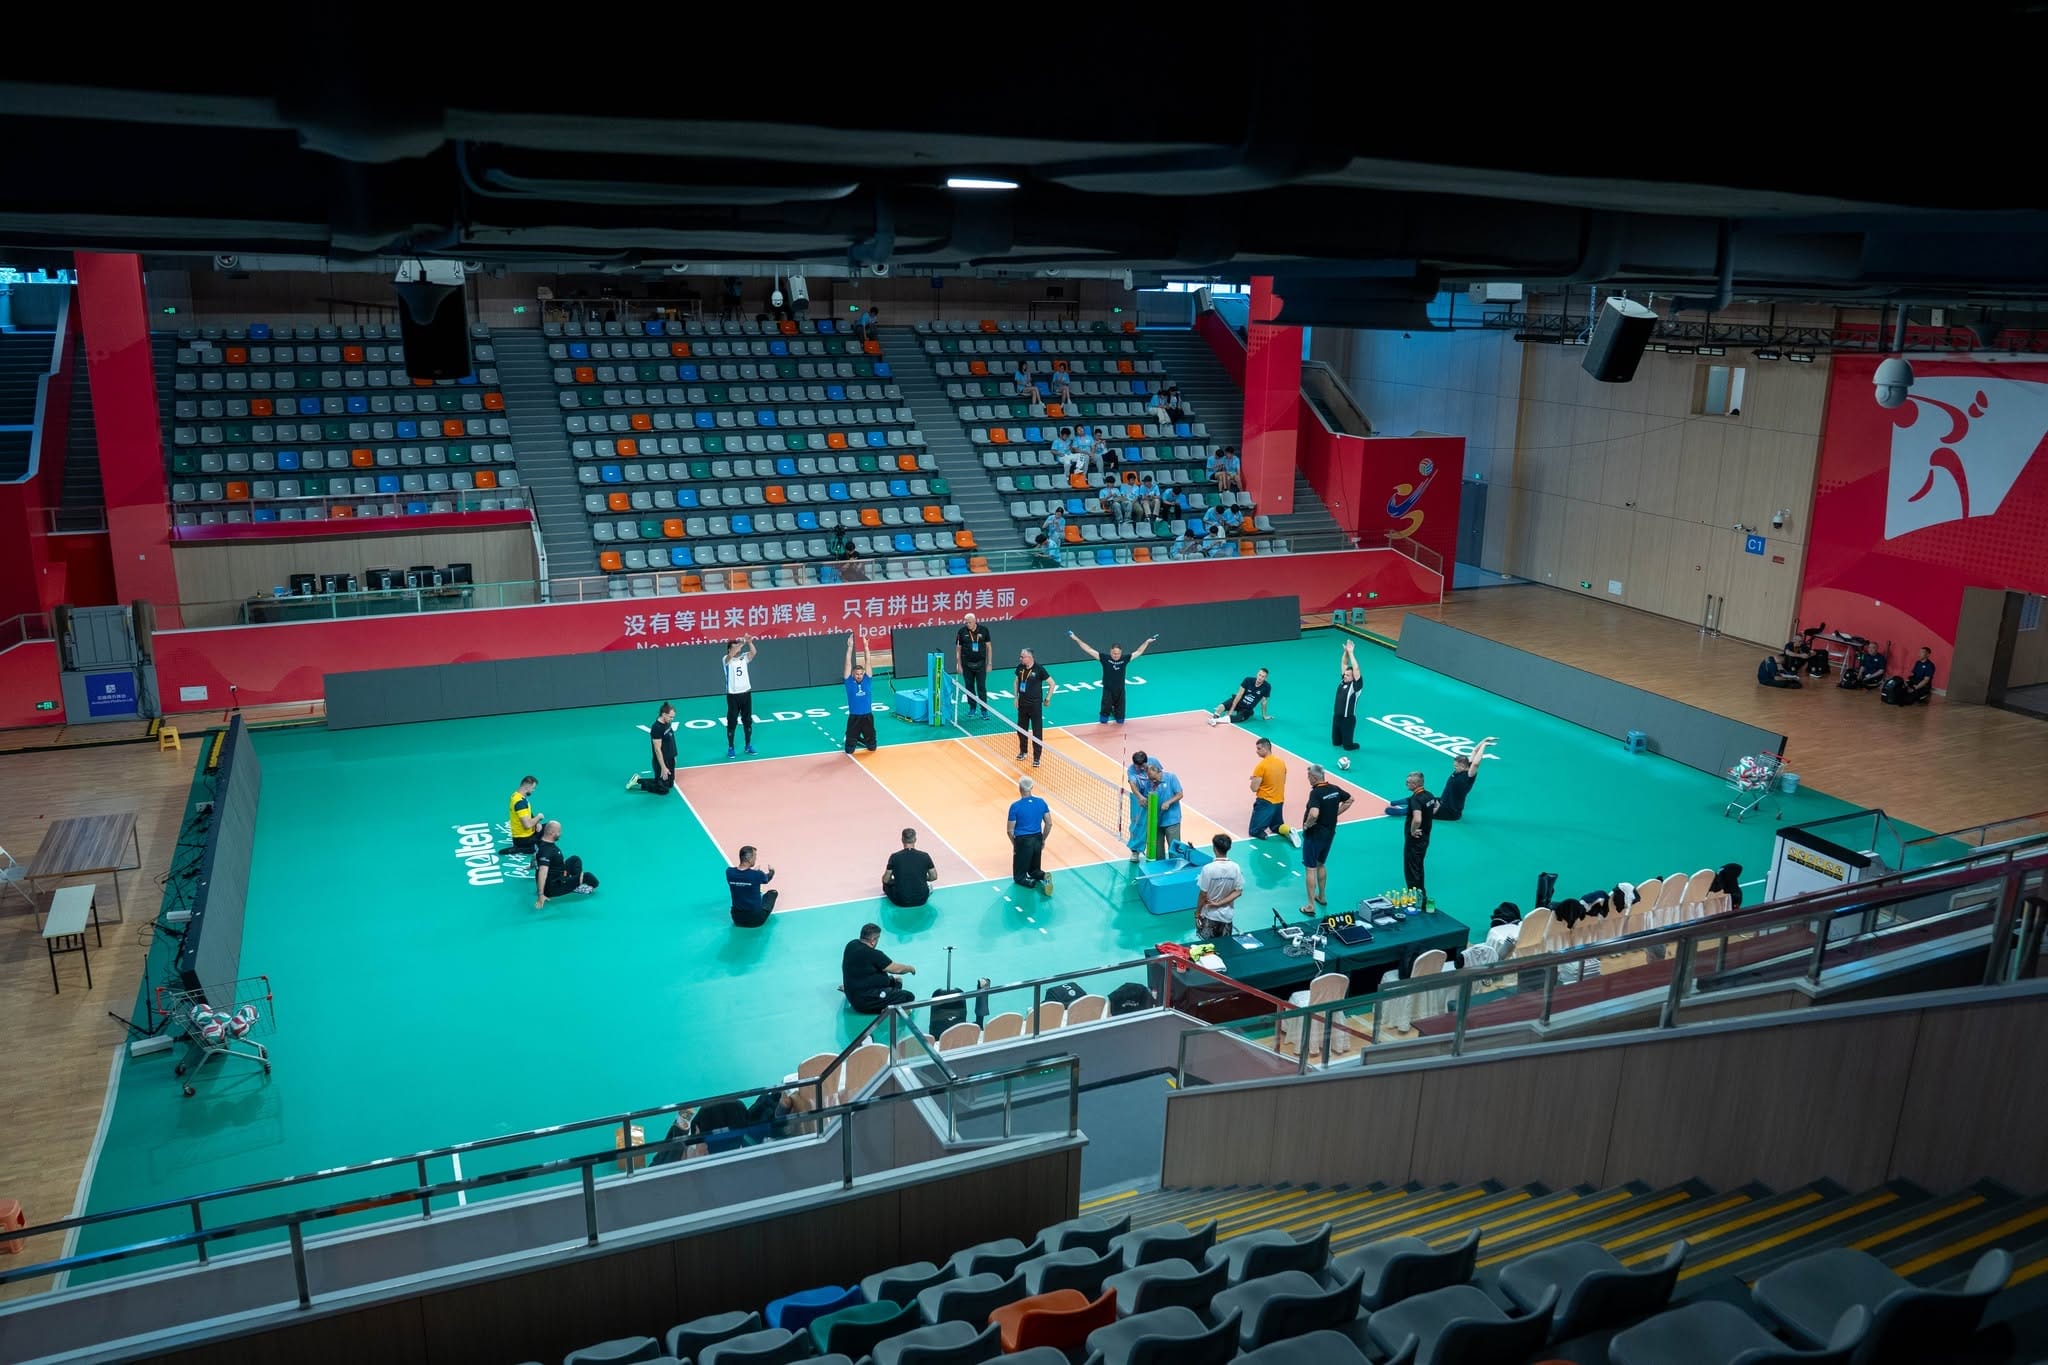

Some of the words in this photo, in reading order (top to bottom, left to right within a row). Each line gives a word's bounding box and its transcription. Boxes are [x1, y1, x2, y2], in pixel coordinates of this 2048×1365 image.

[1748, 539, 1762, 551] C1
[859, 621, 912, 637] beaut
[736, 667, 743, 677] 5
[454, 822, 504, 886] molten
